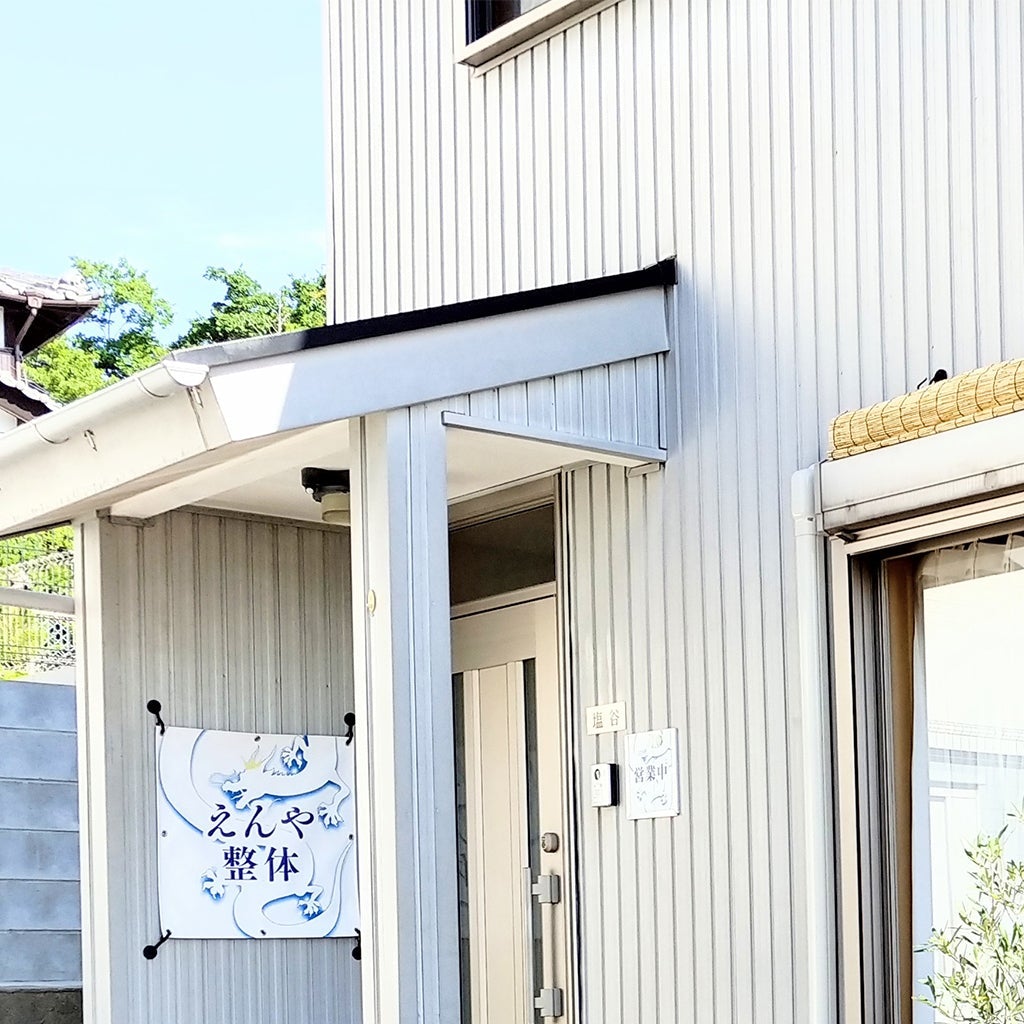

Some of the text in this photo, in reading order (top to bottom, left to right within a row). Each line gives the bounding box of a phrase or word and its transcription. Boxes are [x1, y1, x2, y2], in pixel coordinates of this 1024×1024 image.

[634, 763, 668, 784] 営業中
[207, 803, 315, 839] えんや
[222, 845, 300, 882] 整体
